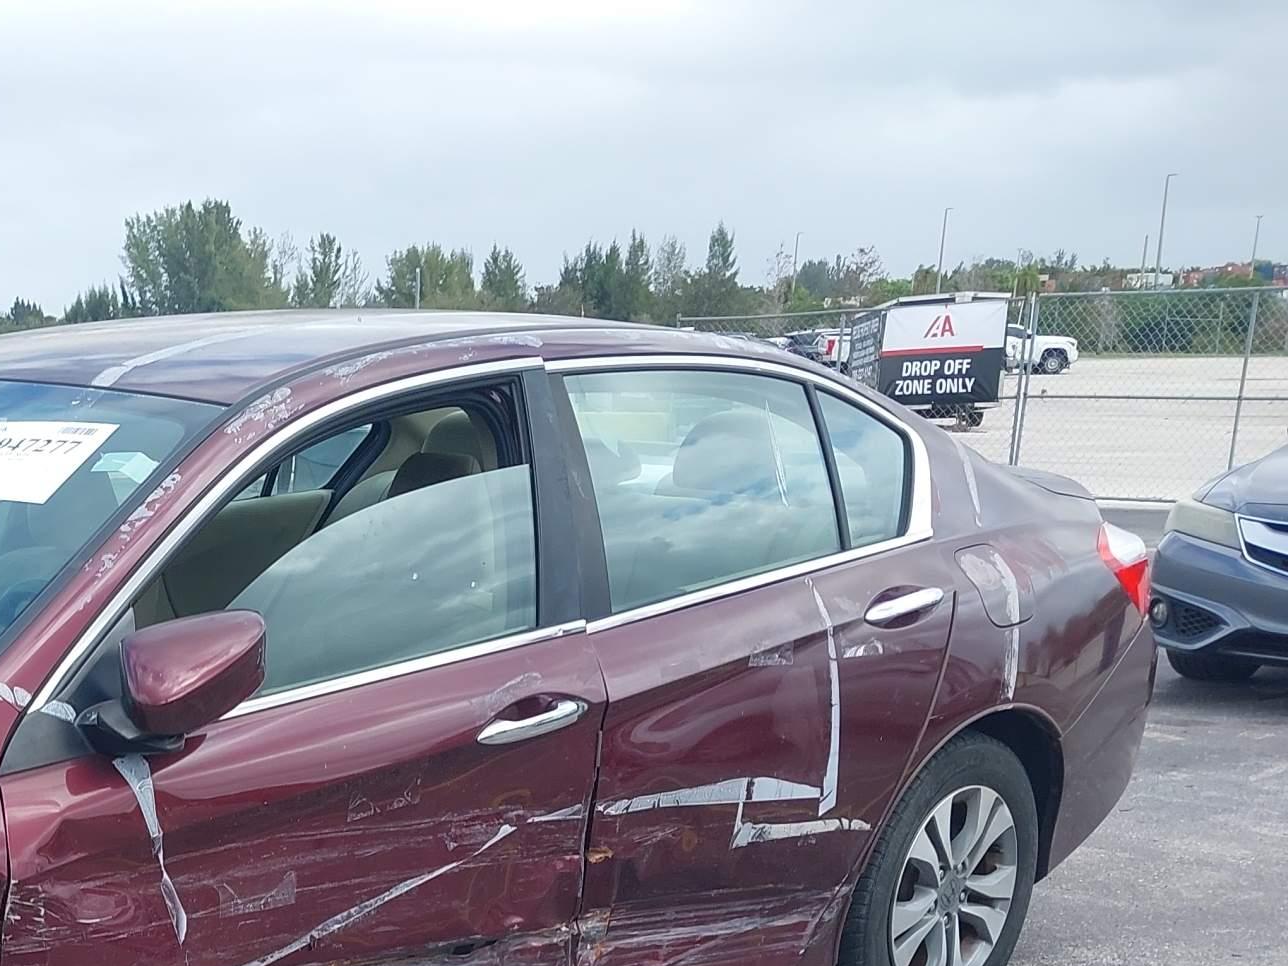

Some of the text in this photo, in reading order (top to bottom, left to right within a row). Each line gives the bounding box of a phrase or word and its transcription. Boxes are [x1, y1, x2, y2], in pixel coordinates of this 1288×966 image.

[902, 358, 972, 377] DROP OFF
[895, 377, 975, 396] ZONE ONLY
